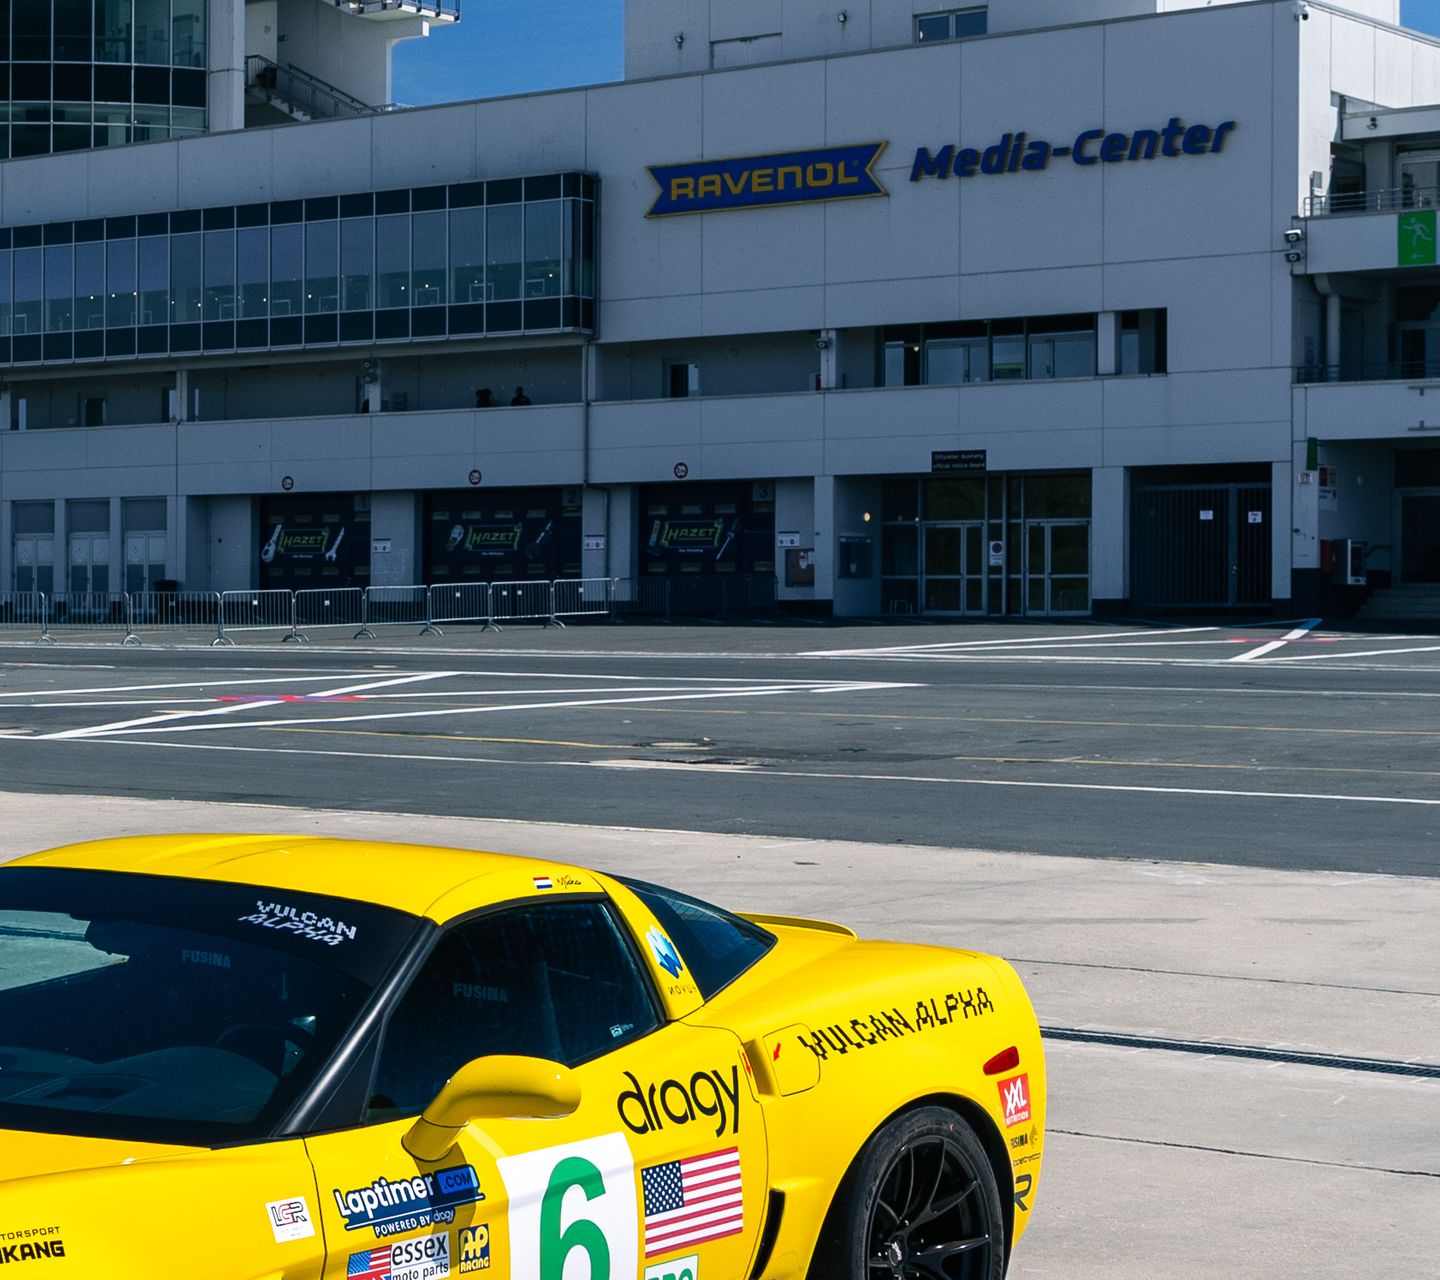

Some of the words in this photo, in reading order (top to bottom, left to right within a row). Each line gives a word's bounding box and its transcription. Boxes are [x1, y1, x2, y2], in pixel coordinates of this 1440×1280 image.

[909, 117, 1236, 183] Media-Center
[670, 160, 858, 201] RAVENOL
[283, 535, 323, 548] HAZET
[471, 532, 516, 545] HAZET
[668, 527, 716, 541] HAZET
[238, 913, 344, 946] ALPHA
[257, 900, 357, 940] VULCAN
[797, 1008, 915, 1060] VULCAN
[916, 987, 994, 1031] ALPHA
[617, 1065, 739, 1138] dragy
[1004, 1077, 1027, 1116] XXL
[335, 1175, 434, 1218] Laptimer
[374, 1218, 417, 1237] POWERED
[418, 1215, 431, 1226] BY
[433, 1209, 454, 1223] dragy
[392, 1234, 448, 1265] essex
[460, 1225, 489, 1259] AP
[422, 1261, 449, 1280] parts
[460, 1257, 489, 1273] RACING
